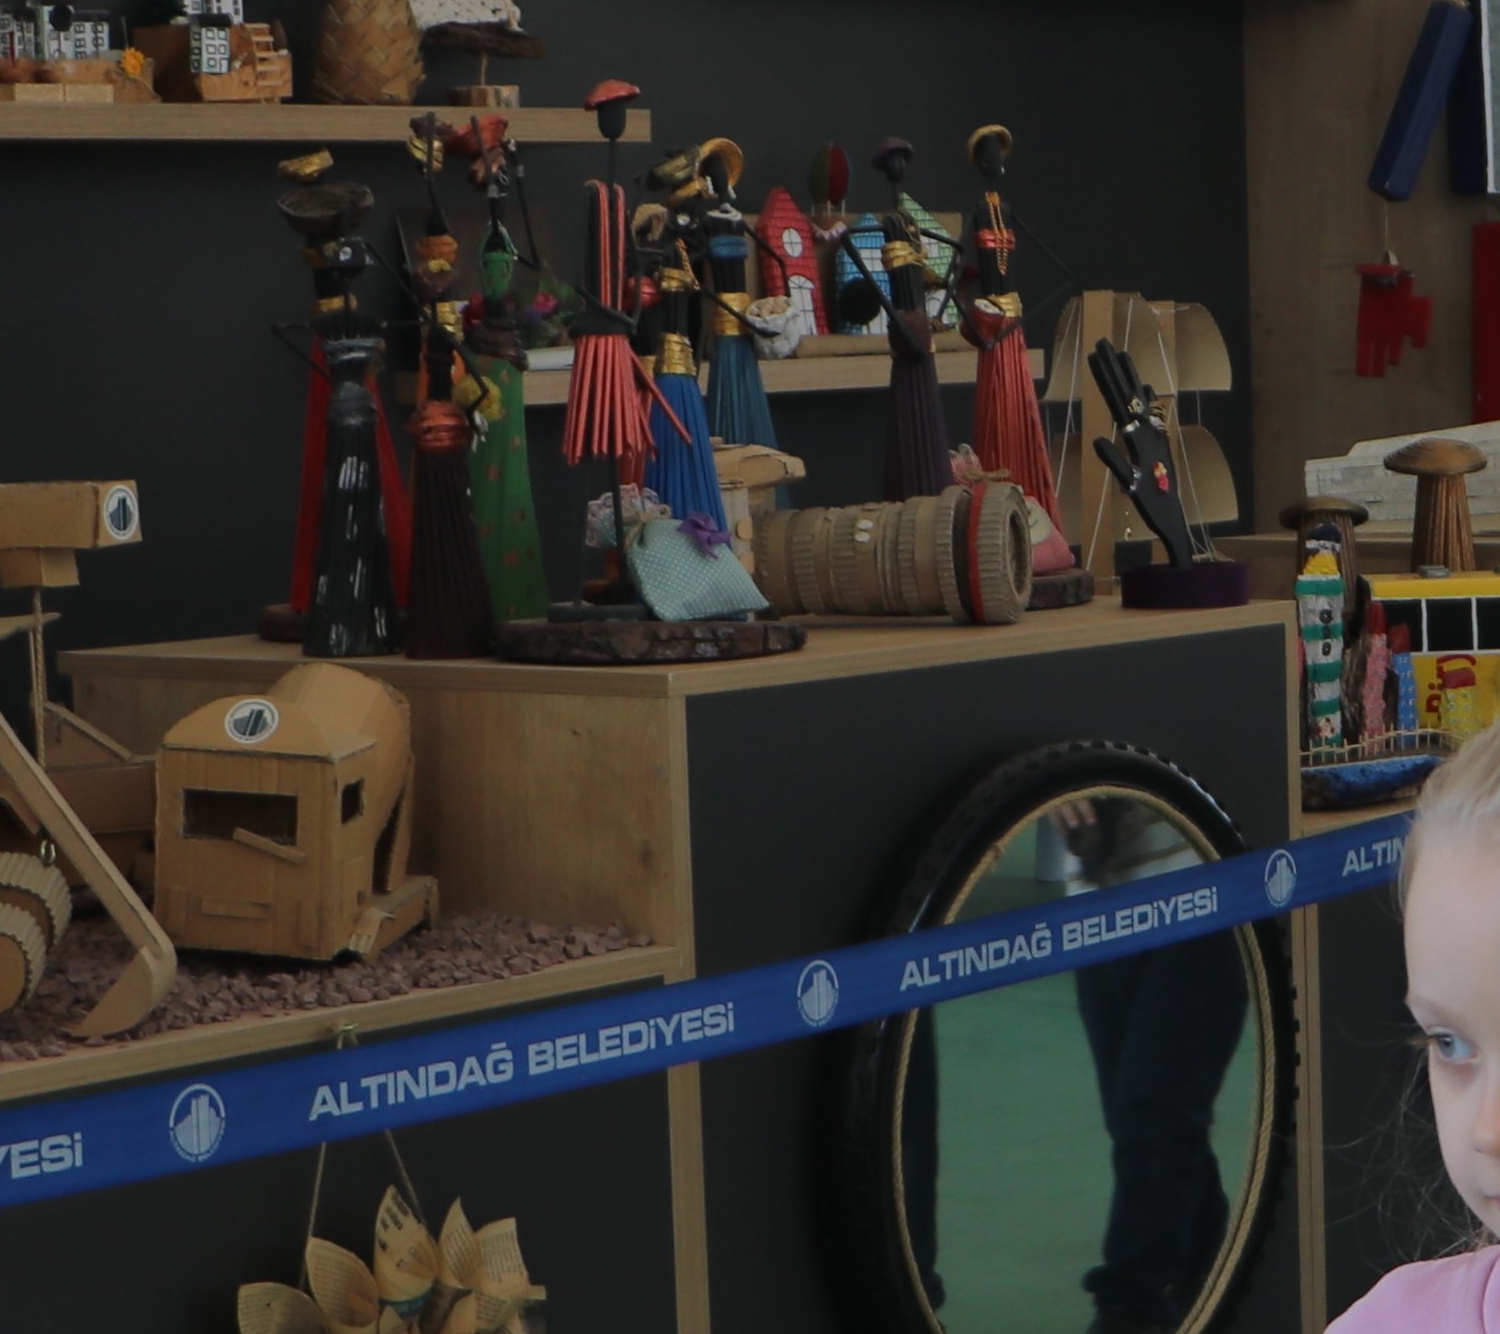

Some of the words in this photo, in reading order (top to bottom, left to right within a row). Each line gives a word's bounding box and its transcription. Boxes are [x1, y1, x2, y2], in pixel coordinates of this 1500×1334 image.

[1341, 836, 1407, 878] ALTIN
[900, 922, 1053, 992] ALTINDAĞ
[309, 1040, 514, 1122] ALTINDAĞ
